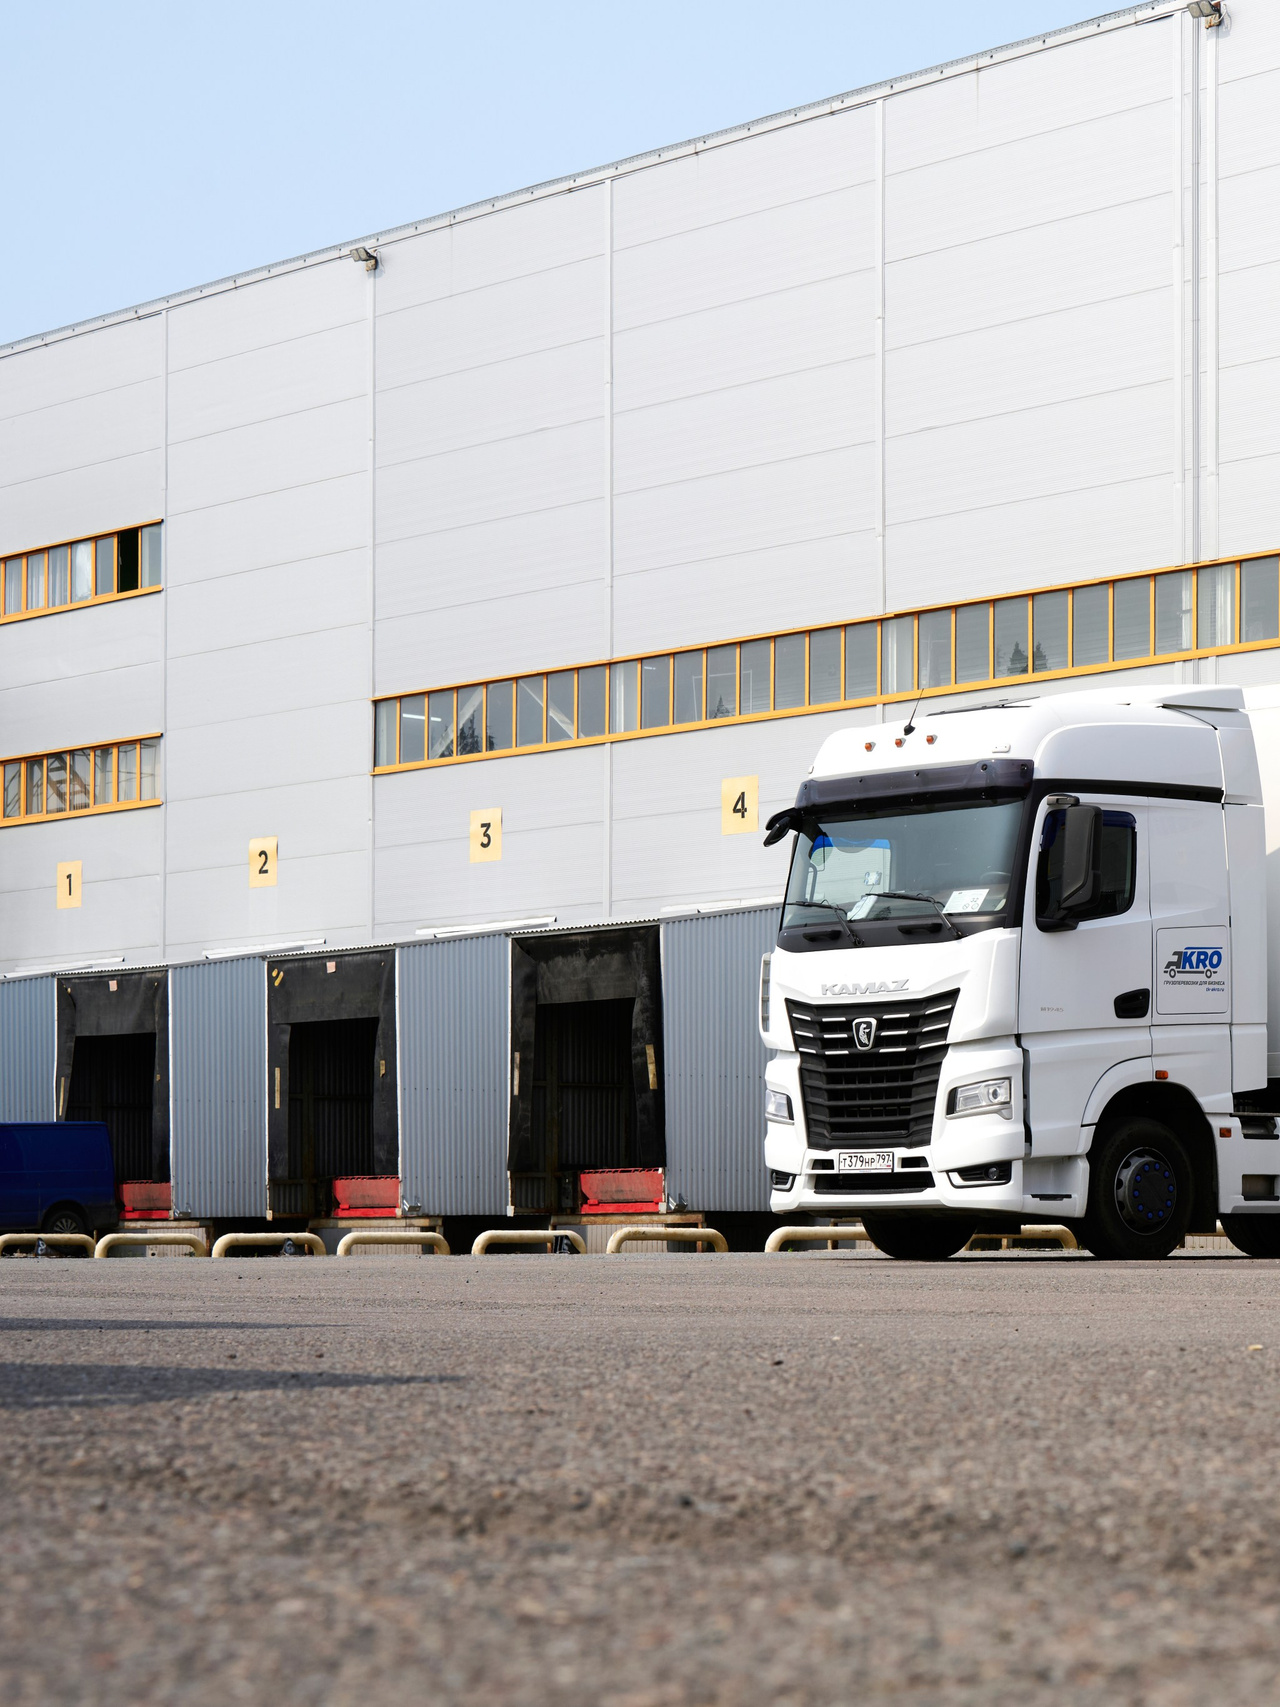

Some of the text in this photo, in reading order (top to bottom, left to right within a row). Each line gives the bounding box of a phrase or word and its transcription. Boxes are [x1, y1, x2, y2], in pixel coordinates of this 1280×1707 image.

[732, 791, 748, 819] 4
[480, 823, 492, 848] 3
[258, 851, 269, 874] 2
[65, 873, 72, 896] 1
[821, 979, 910, 996] KAMAZ
[876, 1153, 891, 1164] 797
